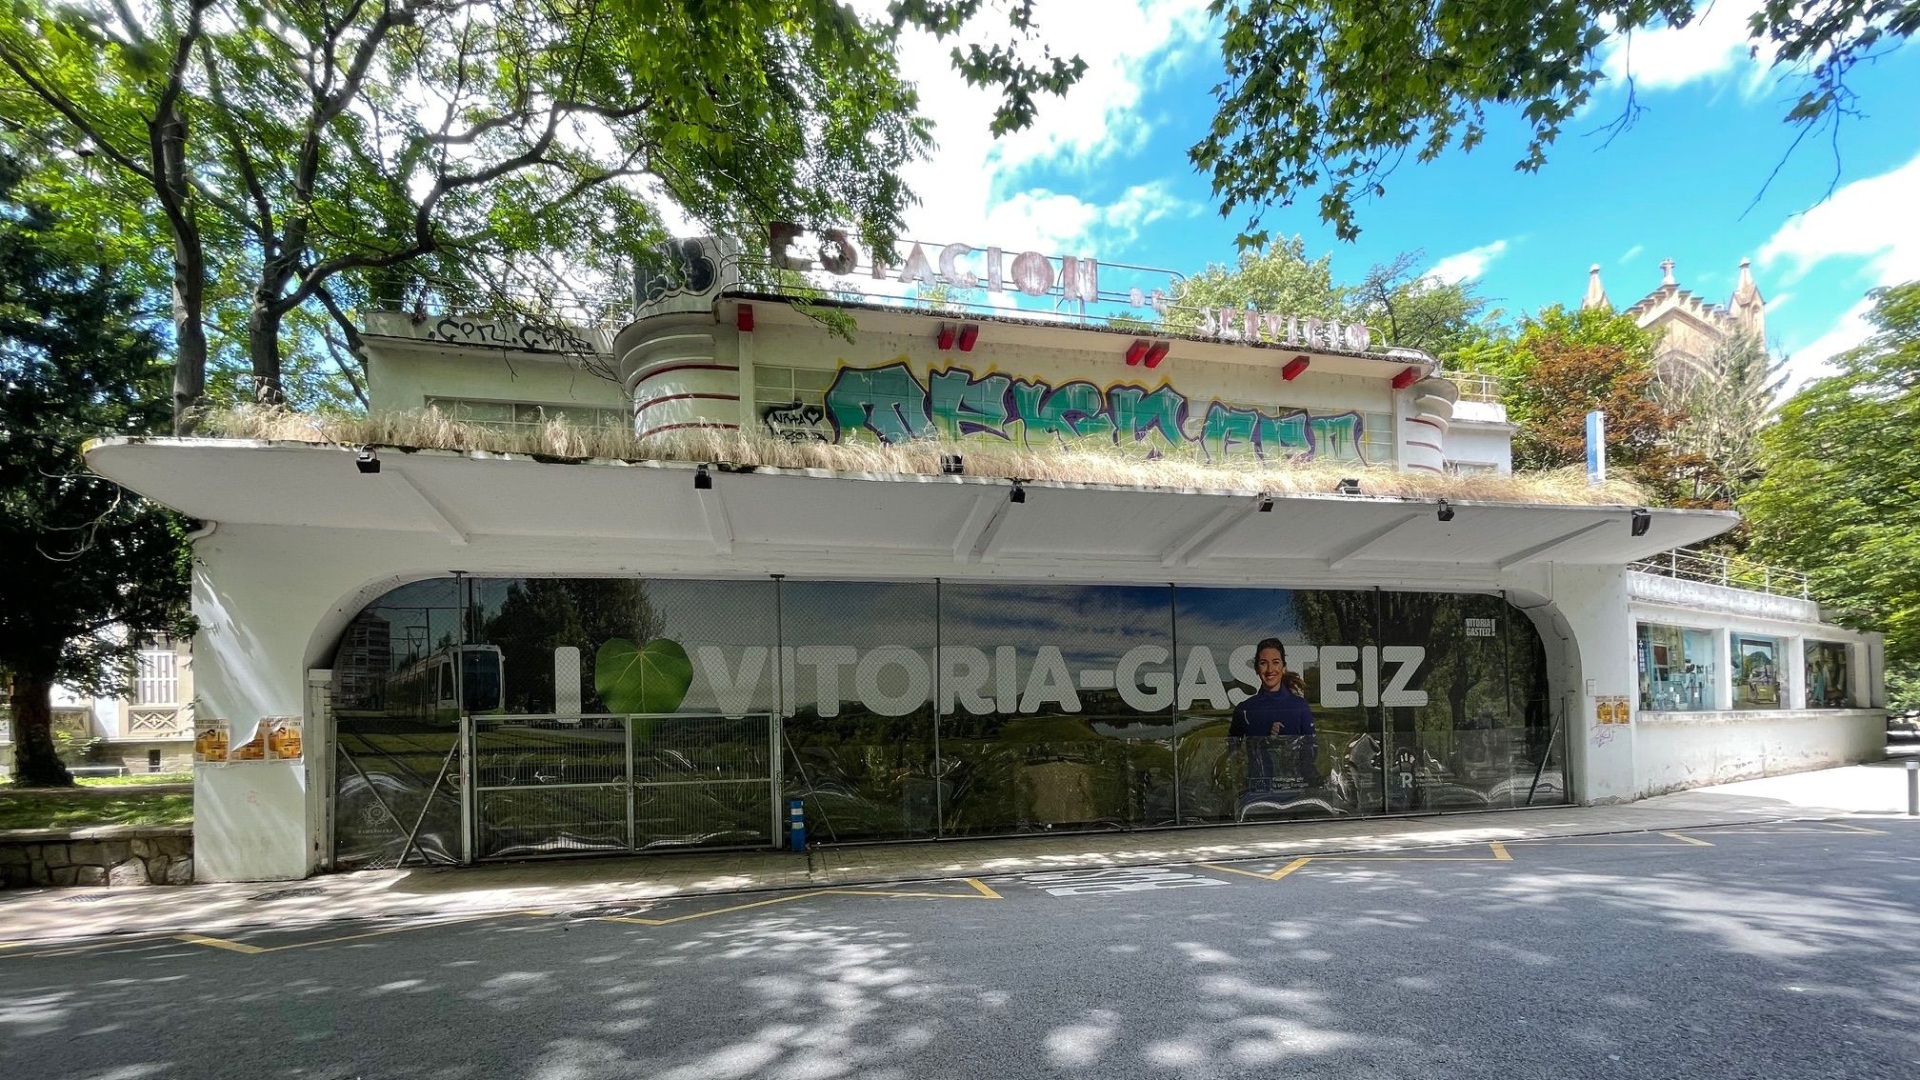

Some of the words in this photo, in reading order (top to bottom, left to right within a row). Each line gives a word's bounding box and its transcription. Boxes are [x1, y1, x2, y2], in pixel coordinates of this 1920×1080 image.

[1465, 618, 1491, 628] VITORIA
[1466, 627, 1491, 637] GASTEIZ
[554, 646, 581, 723] I
[698, 644, 1428, 720] VITORIA-GASTEIZ
